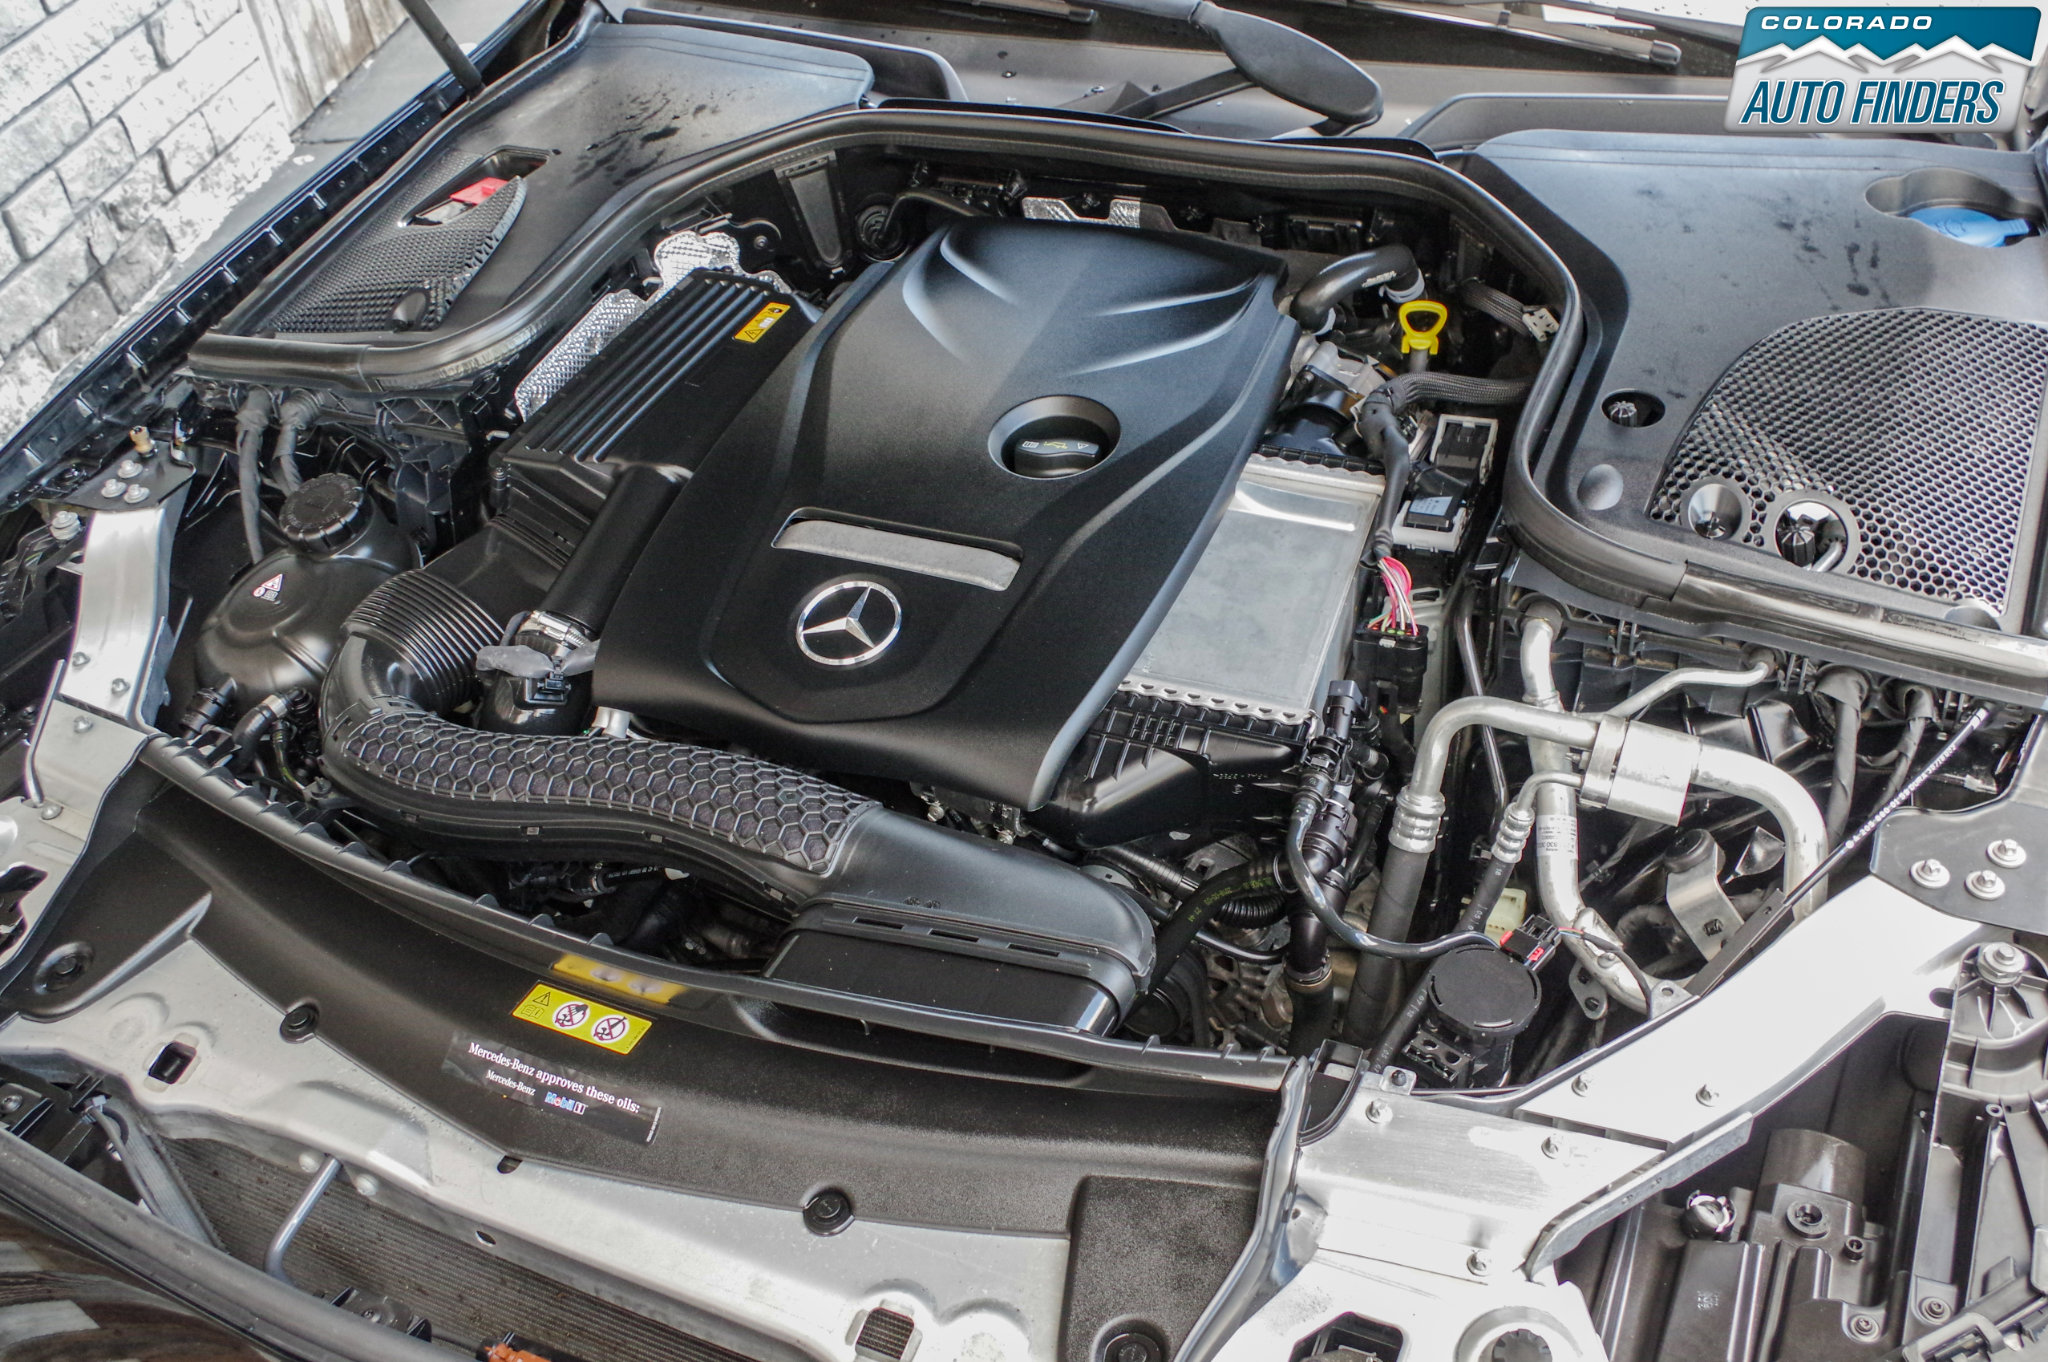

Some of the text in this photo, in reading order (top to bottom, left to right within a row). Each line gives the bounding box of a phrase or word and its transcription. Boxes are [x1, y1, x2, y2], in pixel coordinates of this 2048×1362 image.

[468, 1042, 641, 1114] Mercedes-Benz approves these oils:
[485, 1069, 536, 1096] Mercedes-Benz
[544, 1091, 575, 1112] Mobil
